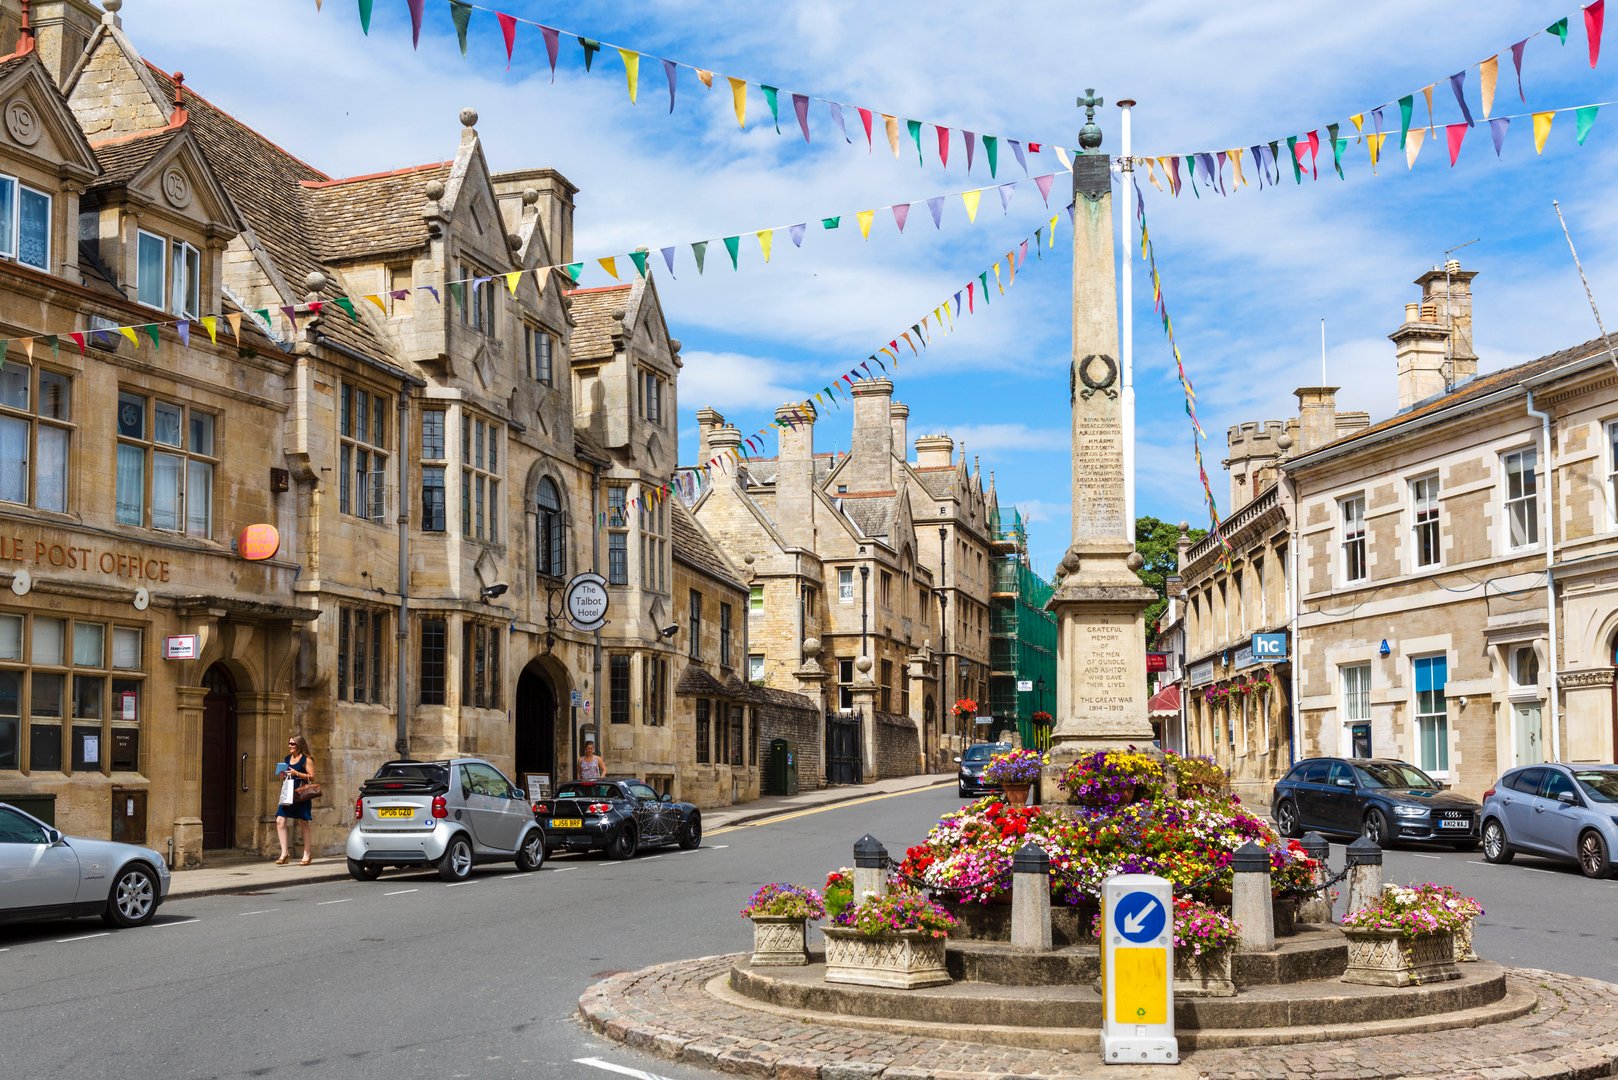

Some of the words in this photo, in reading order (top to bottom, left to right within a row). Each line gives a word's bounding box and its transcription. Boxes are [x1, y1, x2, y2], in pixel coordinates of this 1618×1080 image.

[12, 109, 31, 136] 19
[167, 174, 184, 201] 03
[35, 541, 91, 571] POST
[100, 552, 170, 583] OFFICE
[582, 585, 596, 594] The
[575, 596, 602, 605] Talbot
[577, 608, 599, 617] Hotel
[1257, 636, 1280, 653] hc
[380, 808, 397, 816] GP06
[553, 820, 568, 828] LJ56
